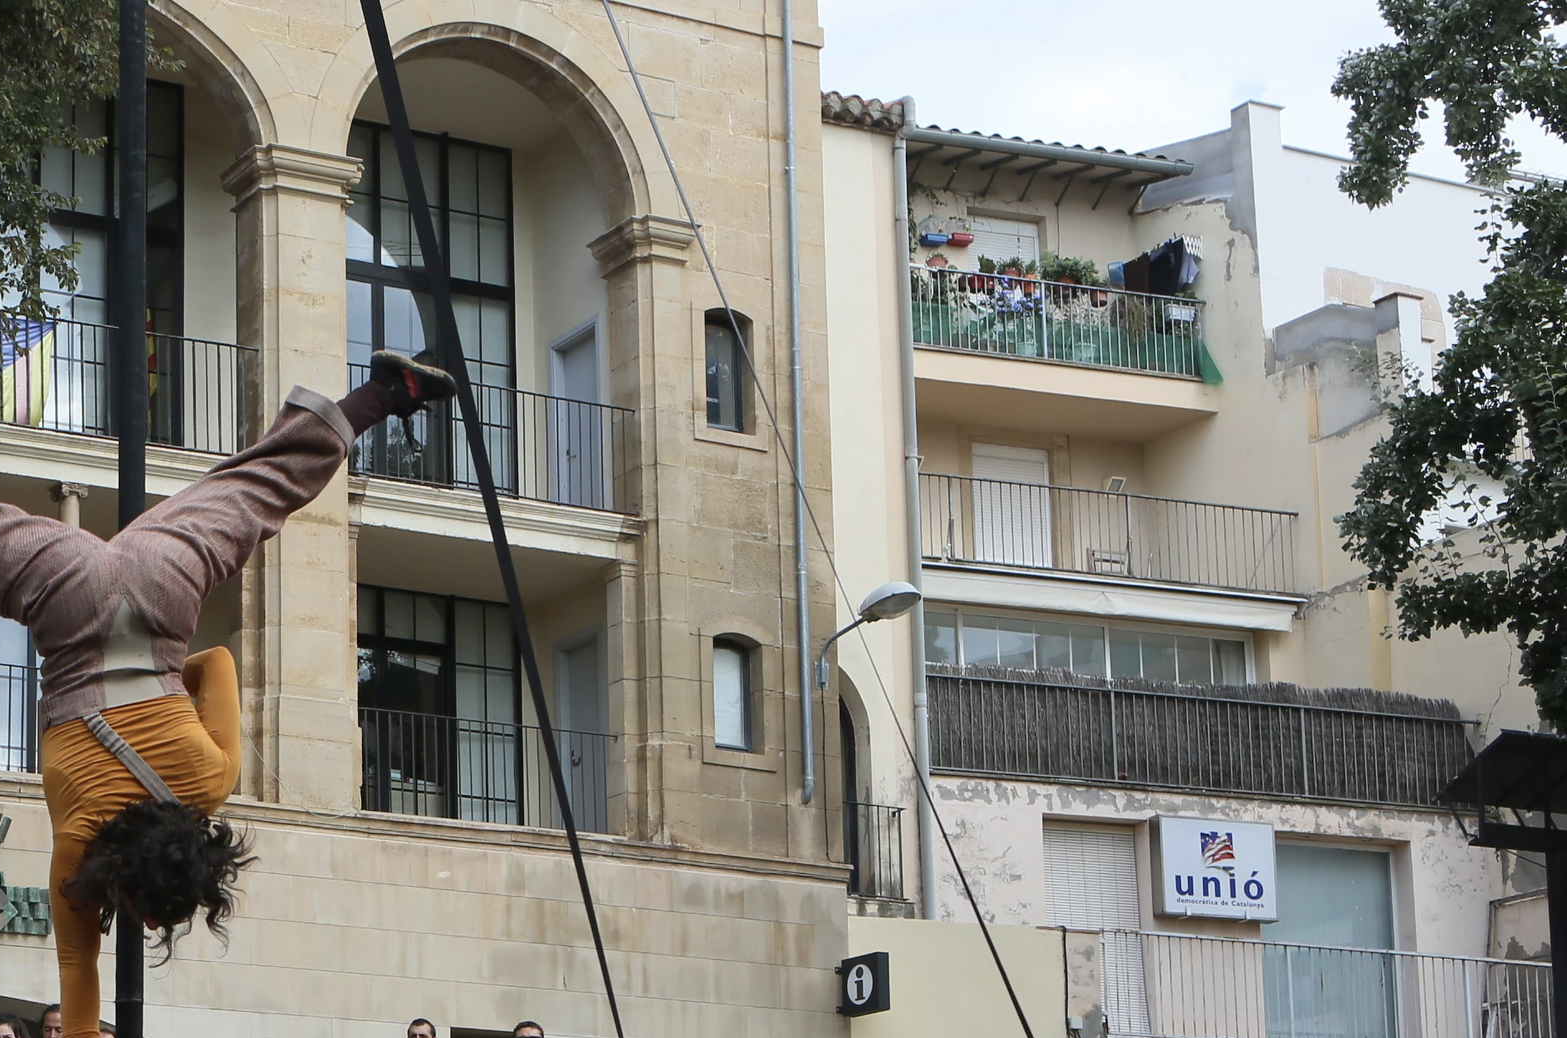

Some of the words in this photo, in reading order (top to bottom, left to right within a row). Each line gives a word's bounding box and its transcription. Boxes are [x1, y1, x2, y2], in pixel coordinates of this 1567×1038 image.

[1174, 870, 1264, 900] unió
[1176, 897, 1219, 906] democràtica
[1231, 900, 1265, 909] Catalunya
